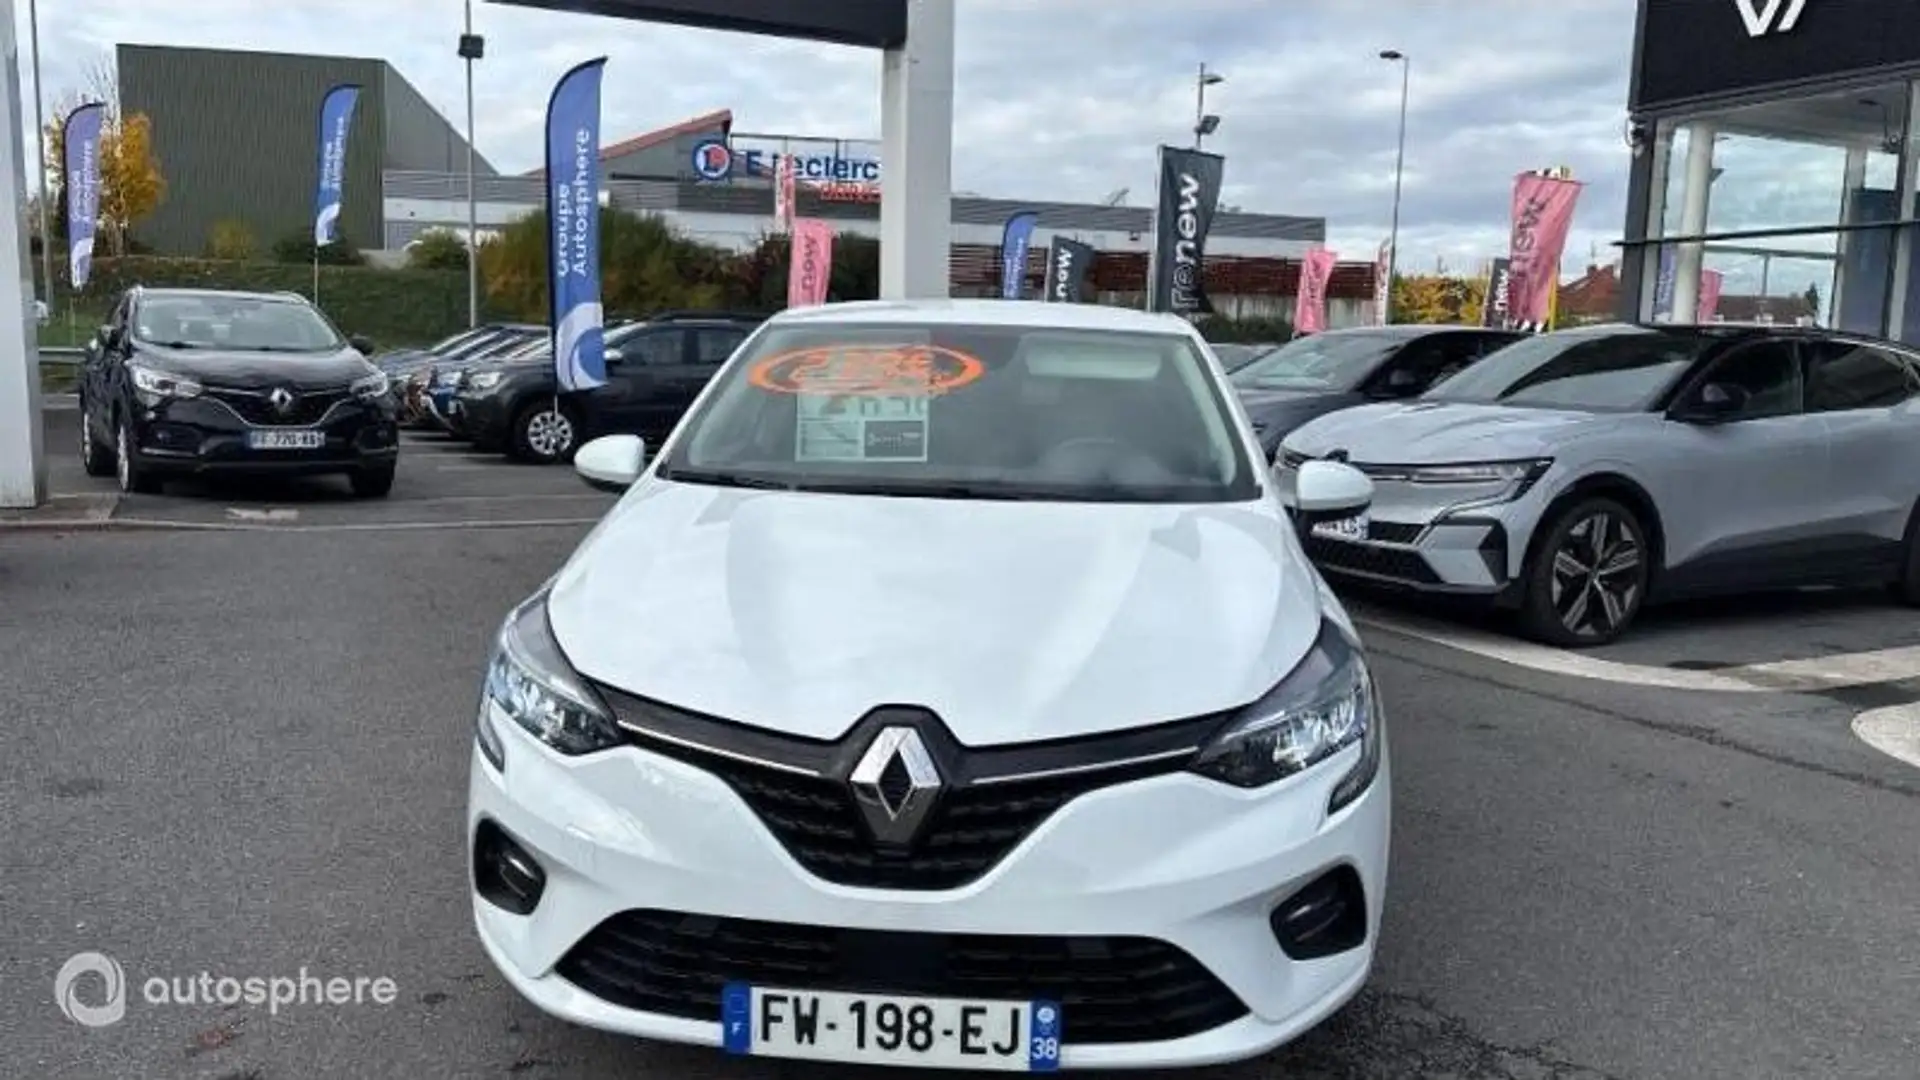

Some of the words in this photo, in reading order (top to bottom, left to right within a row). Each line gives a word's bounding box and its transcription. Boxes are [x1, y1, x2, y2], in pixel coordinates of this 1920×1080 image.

[557, 183, 574, 278] Groupe
[572, 127, 592, 277] Autosphere
[1170, 173, 1200, 309] renew
[761, 993, 1021, 1057] FW-198-EJ
[1032, 1037, 1058, 1061] 38
